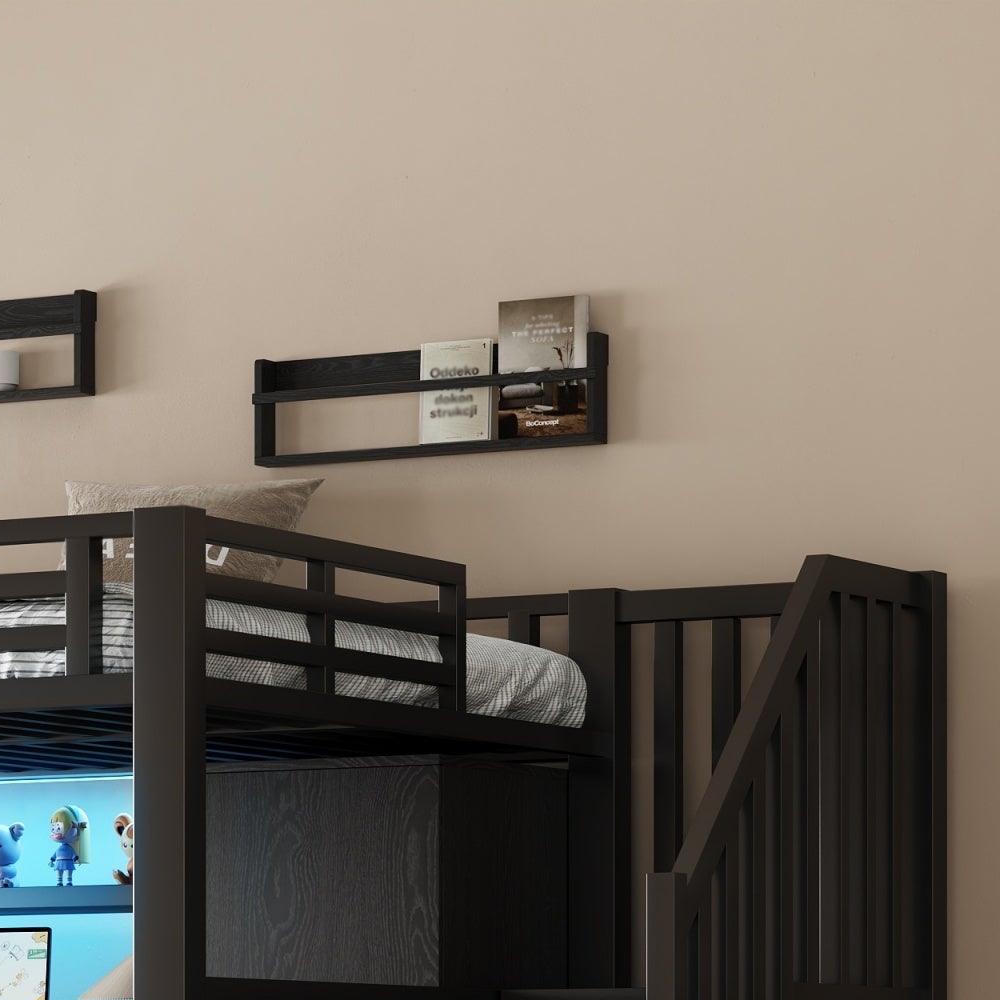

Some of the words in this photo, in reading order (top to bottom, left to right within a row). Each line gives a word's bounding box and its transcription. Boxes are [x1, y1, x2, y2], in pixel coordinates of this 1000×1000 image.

[532, 326, 574, 336] PERFECT
[430, 365, 479, 379] Oddeko
[525, 419, 559, 427] BoConcept
